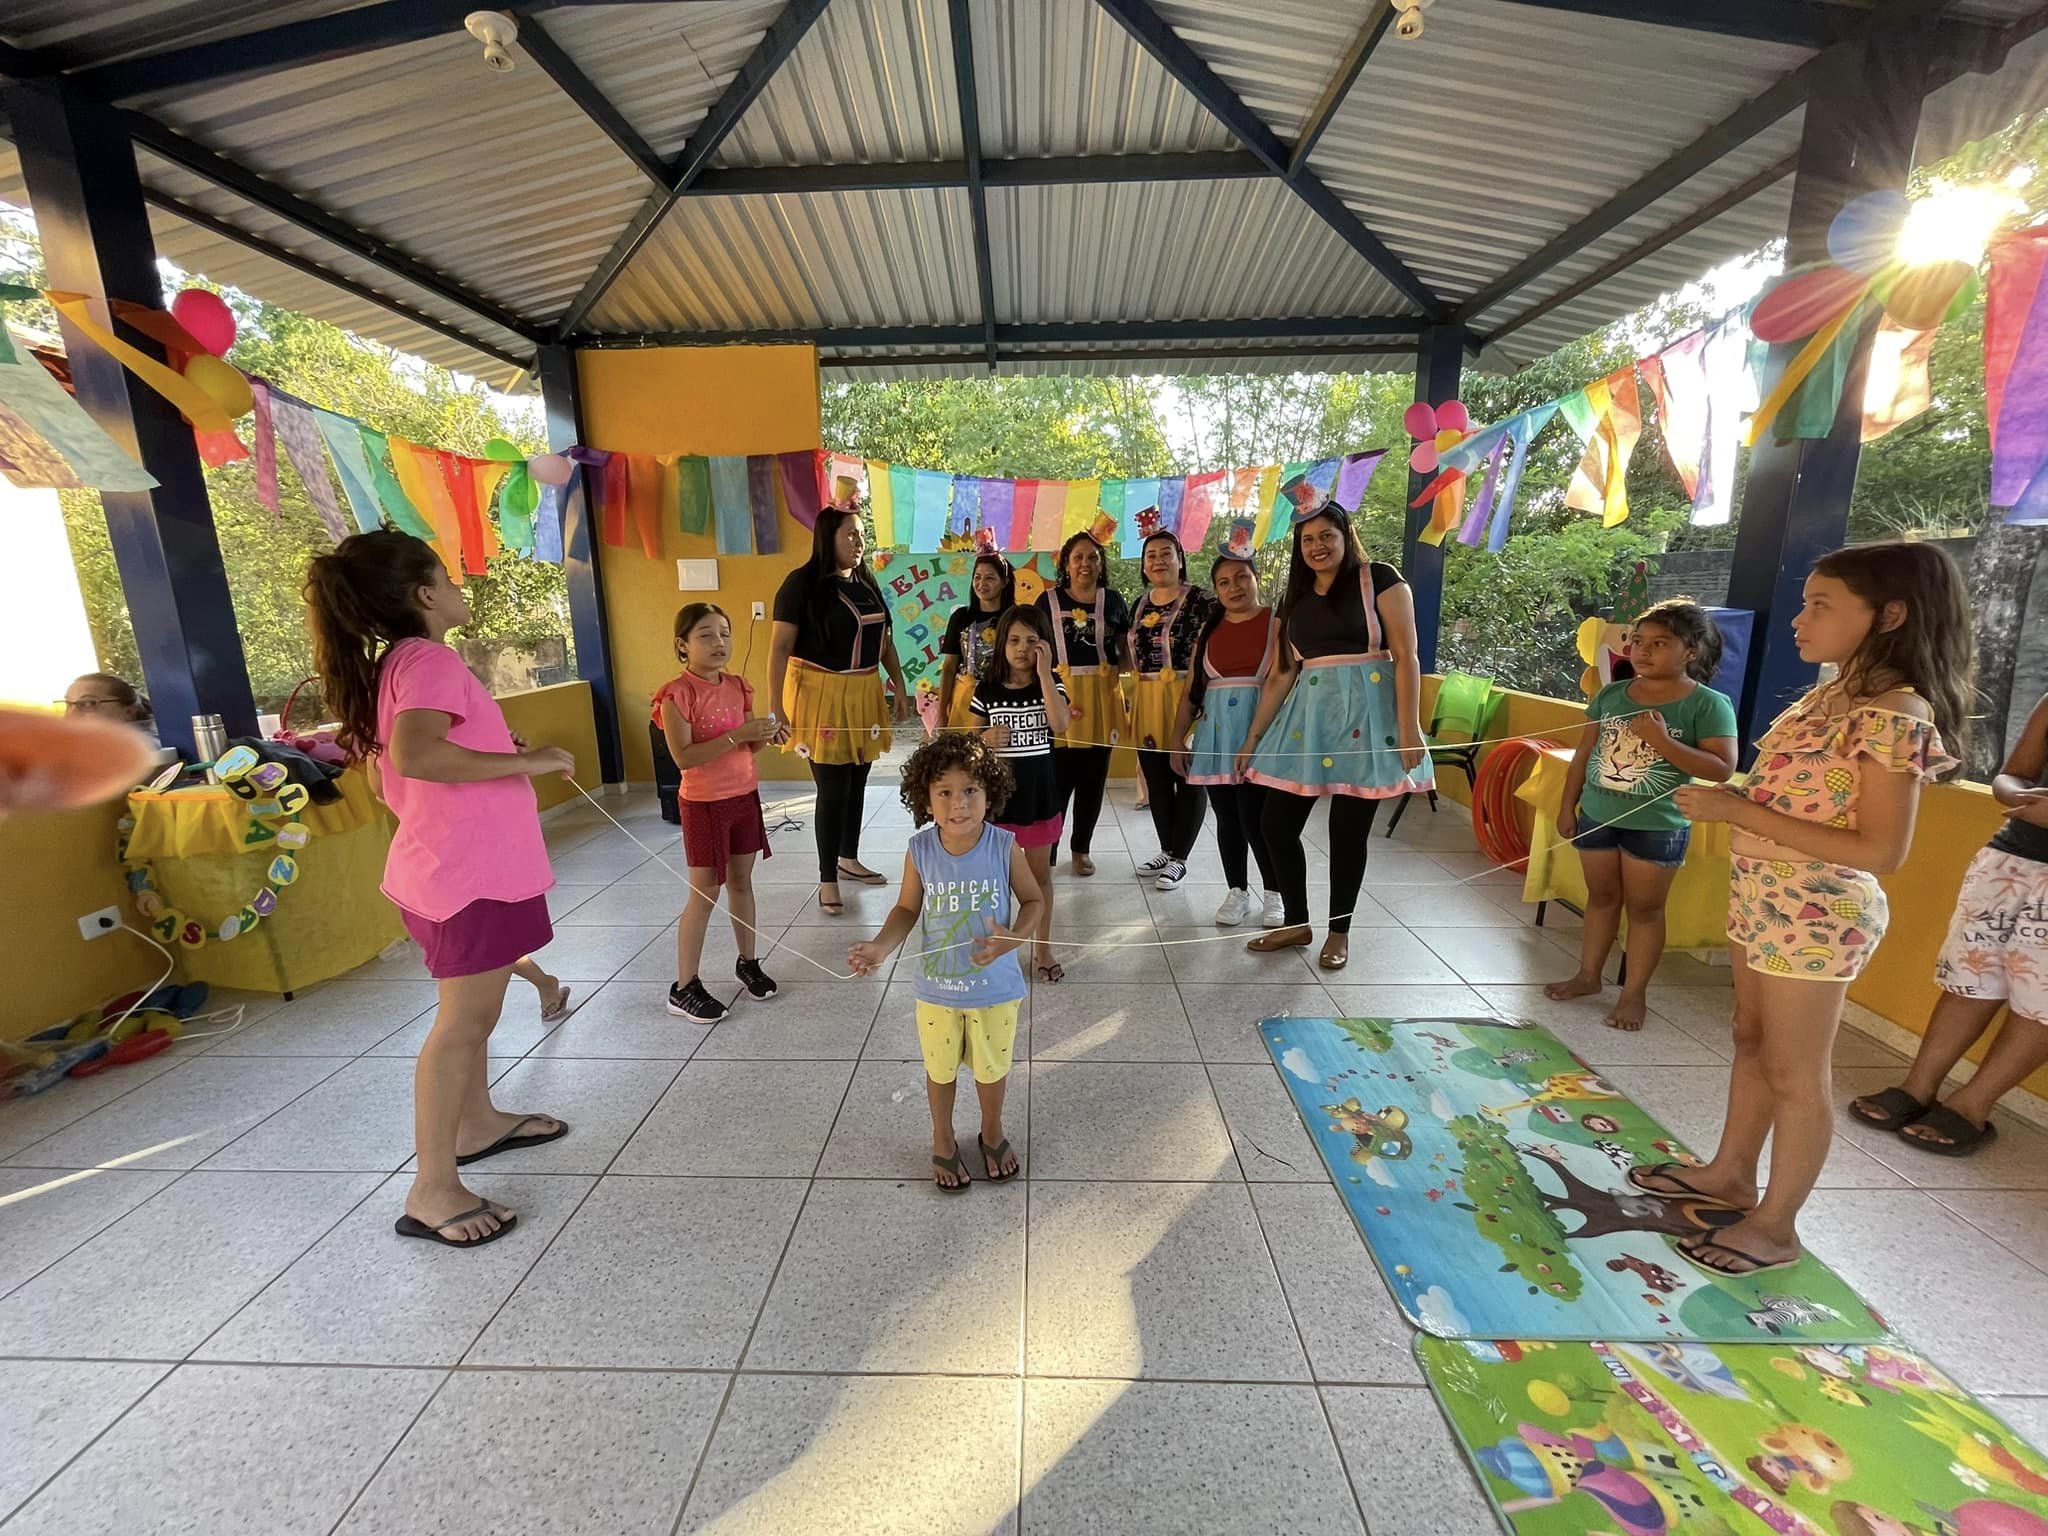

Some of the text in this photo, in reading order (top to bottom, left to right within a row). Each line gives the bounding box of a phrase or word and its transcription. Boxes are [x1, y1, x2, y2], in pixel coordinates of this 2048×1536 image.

[898, 581, 958, 622] DIA
[992, 712, 1048, 729] PERFECTL
[1010, 729, 1048, 746] ERFECT
[926, 878, 1000, 896] ROPICAL
[926, 975, 988, 986] ALWAYS
